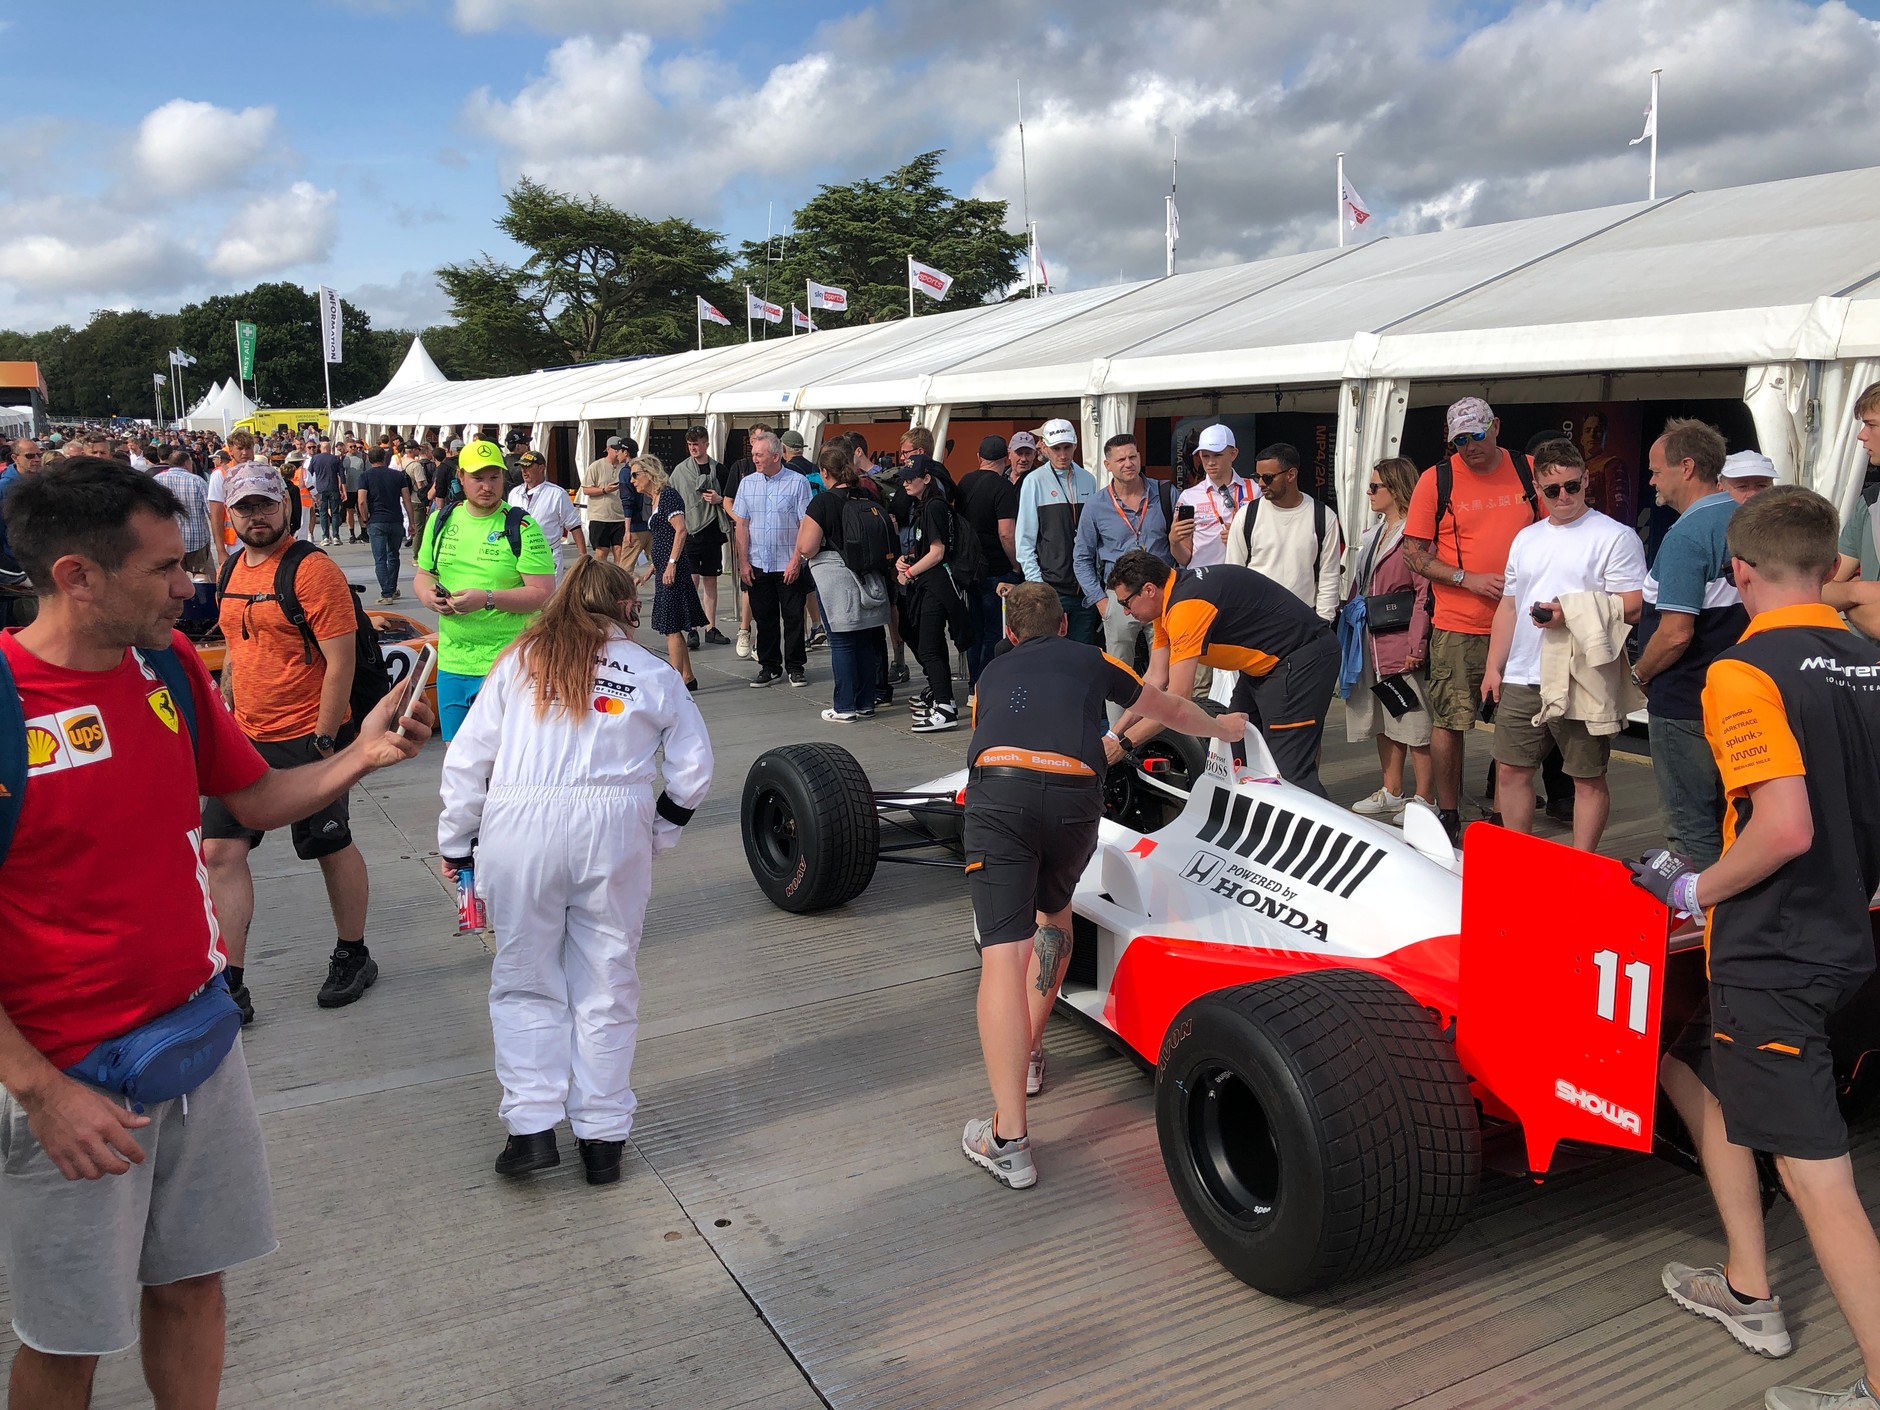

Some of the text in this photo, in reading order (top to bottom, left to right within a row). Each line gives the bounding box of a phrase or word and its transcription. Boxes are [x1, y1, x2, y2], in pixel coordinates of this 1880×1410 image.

[825, 293, 844, 303] sports
[327, 290, 337, 360] INFORMATION
[1316, 425, 1326, 488] MP4/2A
[1176, 465, 1184, 491] GILM
[595, 656, 636, 675] HAL
[597, 679, 631, 692] WOOD
[607, 689, 628, 697] SPEED
[1732, 709, 1753, 718] WORLD
[1724, 718, 1758, 734] DARKTRACE
[68, 724, 103, 749] ups
[983, 753, 1022, 763] Bench.
[1031, 756, 1072, 767] Bench.
[1213, 752, 1226, 763] Prost
[1730, 744, 1767, 763] ARROW
[1205, 760, 1228, 778] BOSS
[1734, 762, 1755, 771] RICHARD
[785, 854, 807, 898] AVON
[1227, 864, 1298, 901] POWERED by
[1210, 877, 1329, 943] HONDA
[1593, 948, 1651, 1035] 11
[1157, 1018, 1192, 1084] AVON
[1555, 1078, 1642, 1137] SHOWA
